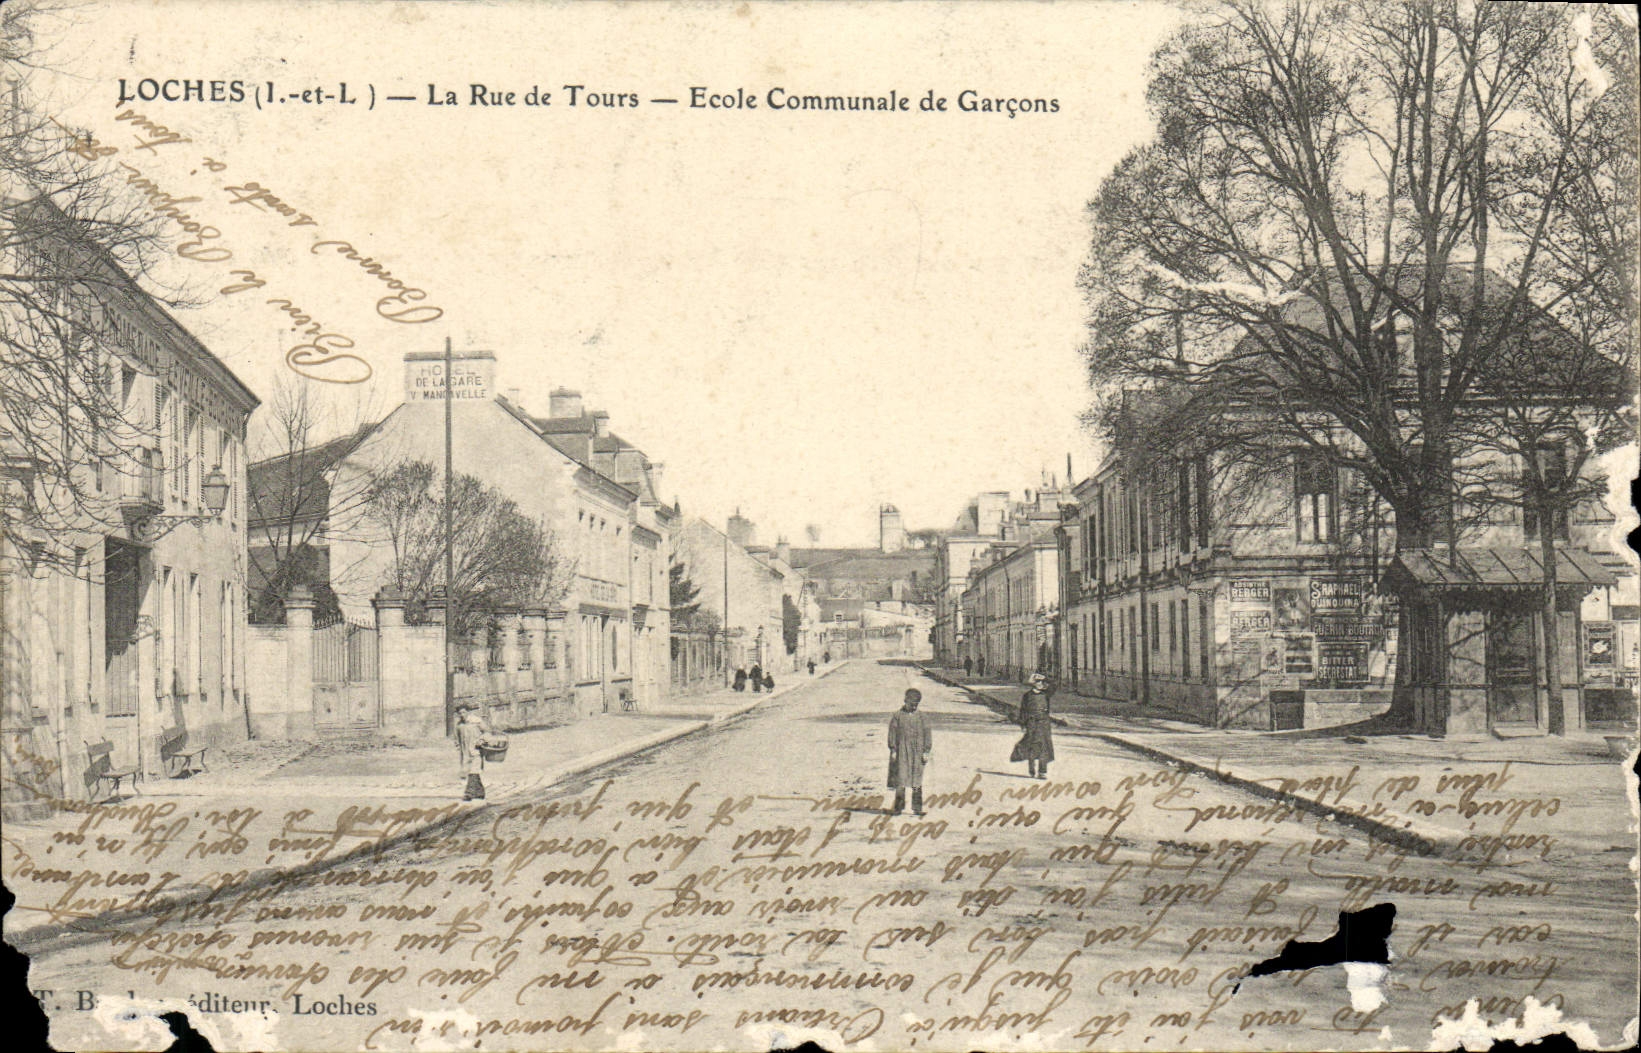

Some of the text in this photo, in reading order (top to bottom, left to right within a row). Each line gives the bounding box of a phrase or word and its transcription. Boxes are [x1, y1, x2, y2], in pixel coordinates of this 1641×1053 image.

[266, 300, 372, 384] Bien
[420, 364, 476, 377] HOEL
[415, 377, 430, 388] DE
[1231, 588, 1270, 598] BERGER
